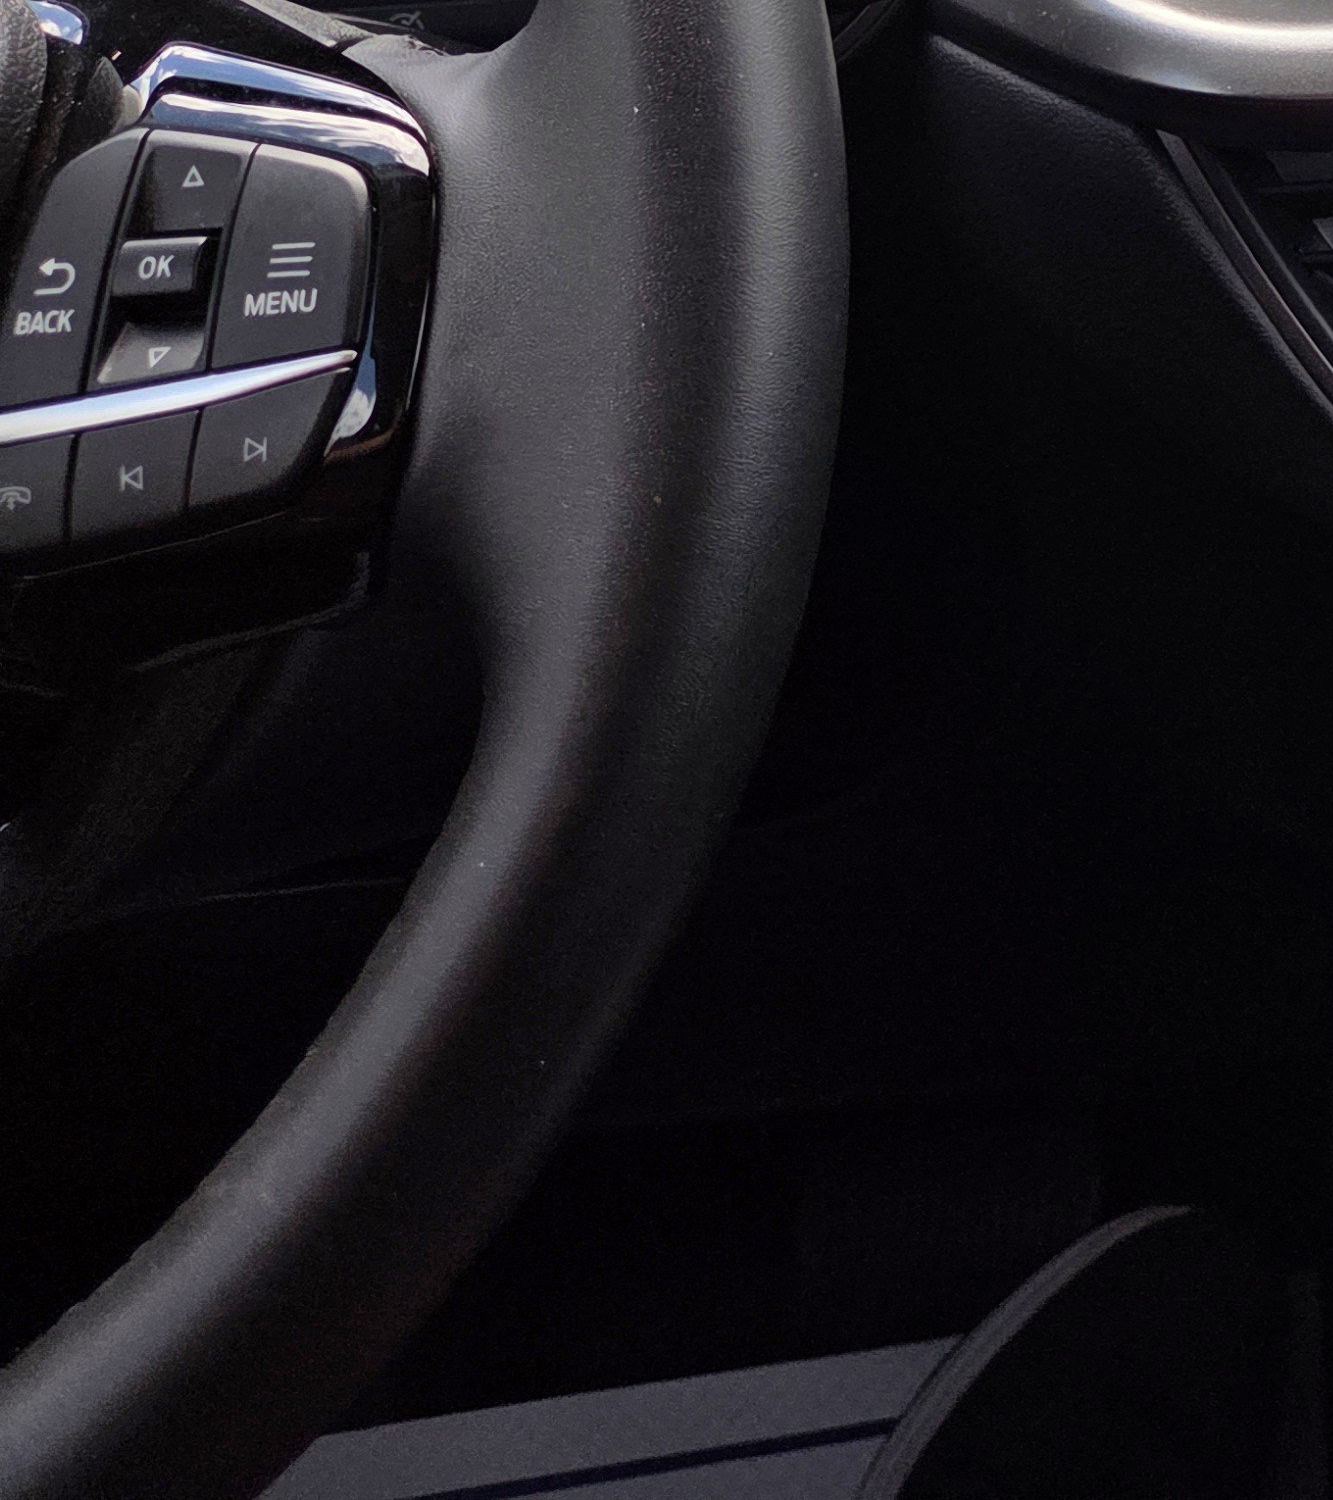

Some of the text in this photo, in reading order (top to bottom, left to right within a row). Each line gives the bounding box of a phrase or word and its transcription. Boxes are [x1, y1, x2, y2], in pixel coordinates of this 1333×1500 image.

[138, 255, 174, 280] OK
[243, 289, 318, 317] MENU
[13, 308, 75, 336] BACK
